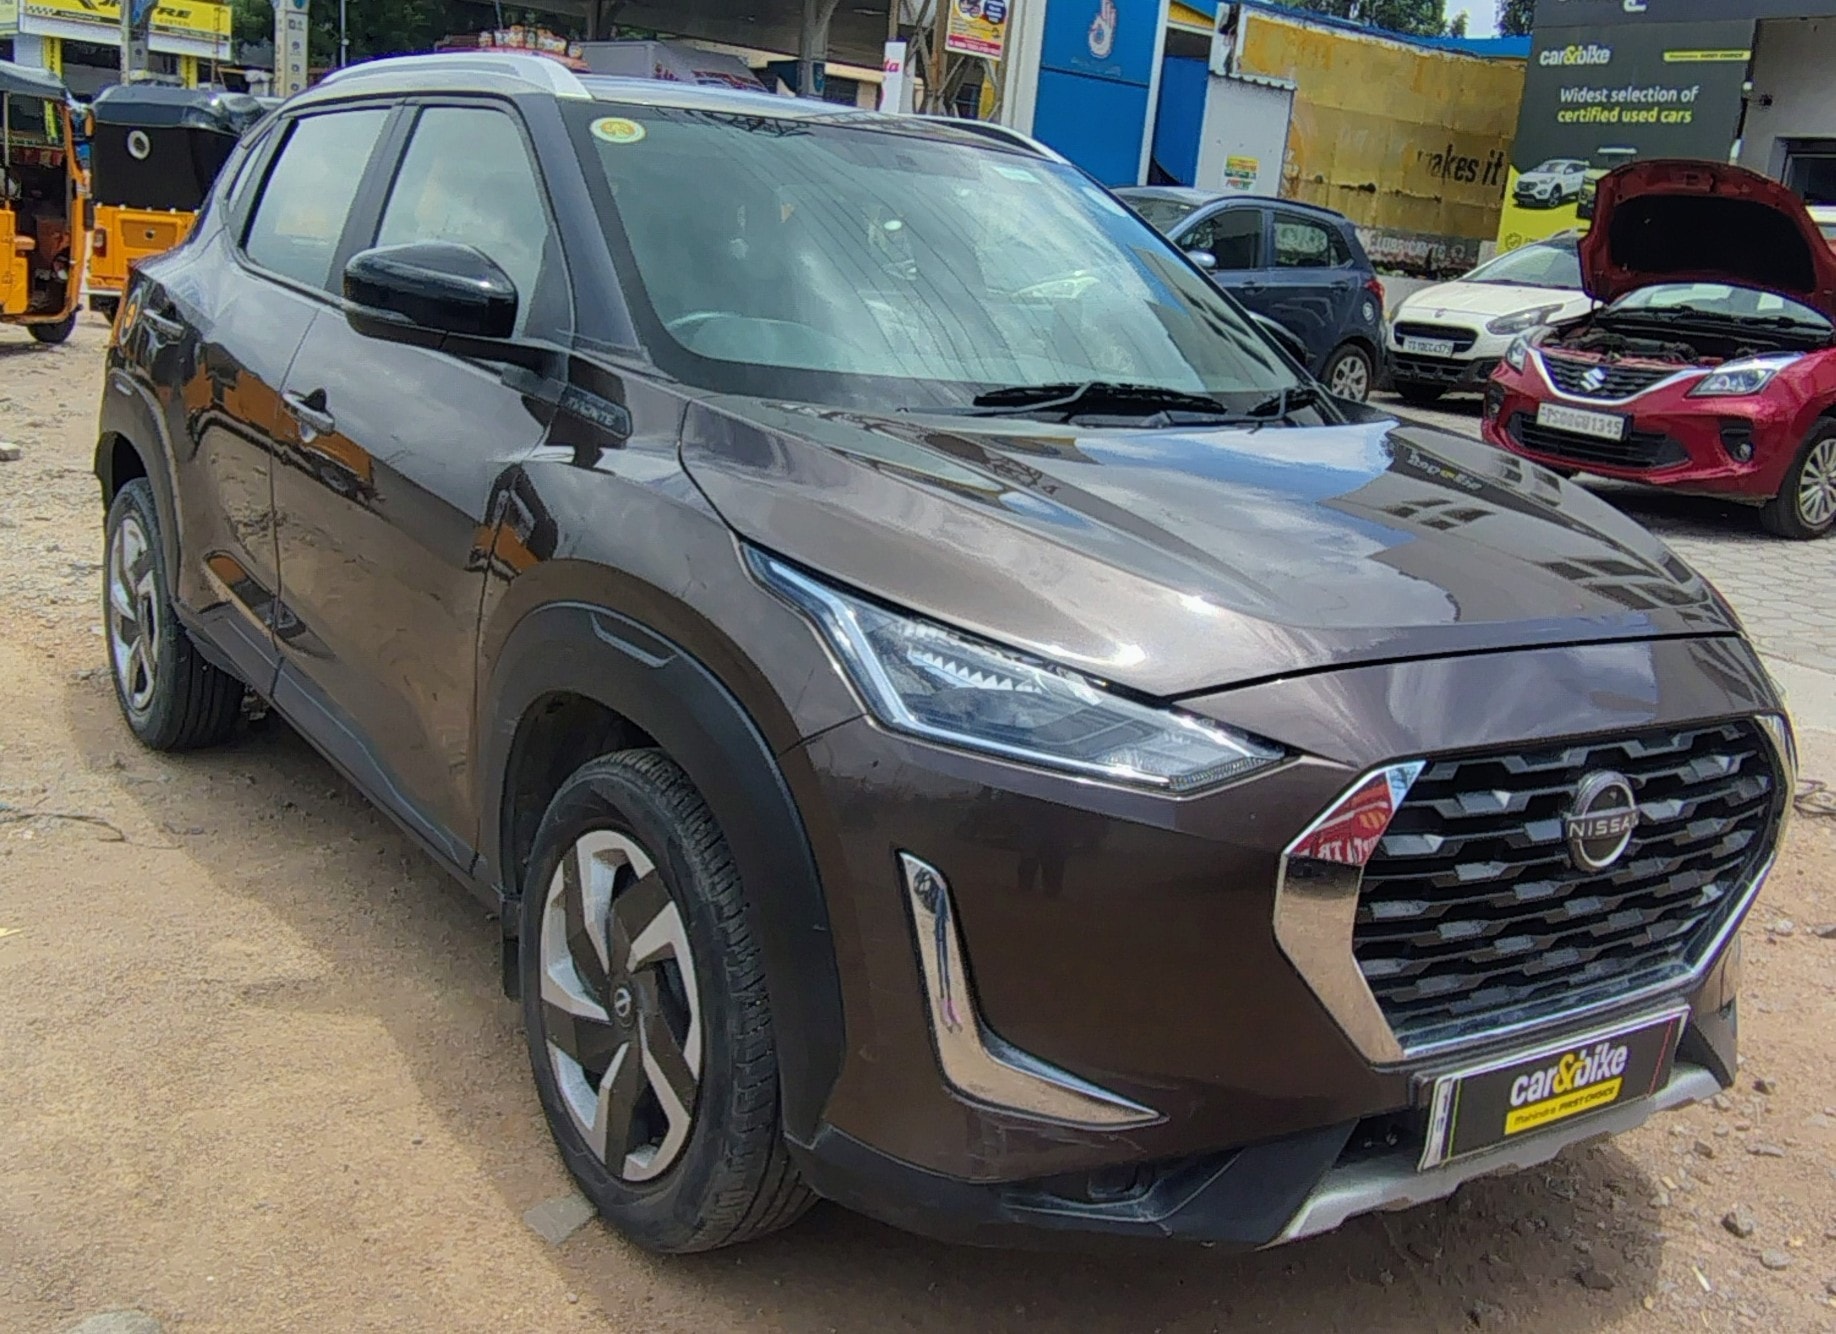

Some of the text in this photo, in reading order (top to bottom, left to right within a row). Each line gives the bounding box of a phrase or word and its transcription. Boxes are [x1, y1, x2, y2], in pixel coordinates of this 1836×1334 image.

[157, 7, 193, 19] RE
[1539, 44, 1612, 66] car&bike
[1560, 85, 1700, 103] Widest selection of
[1557, 106, 1692, 123] certified used cars
[1418, 144, 1504, 186] akes it
[1509, 1042, 1628, 1107] car&bike
